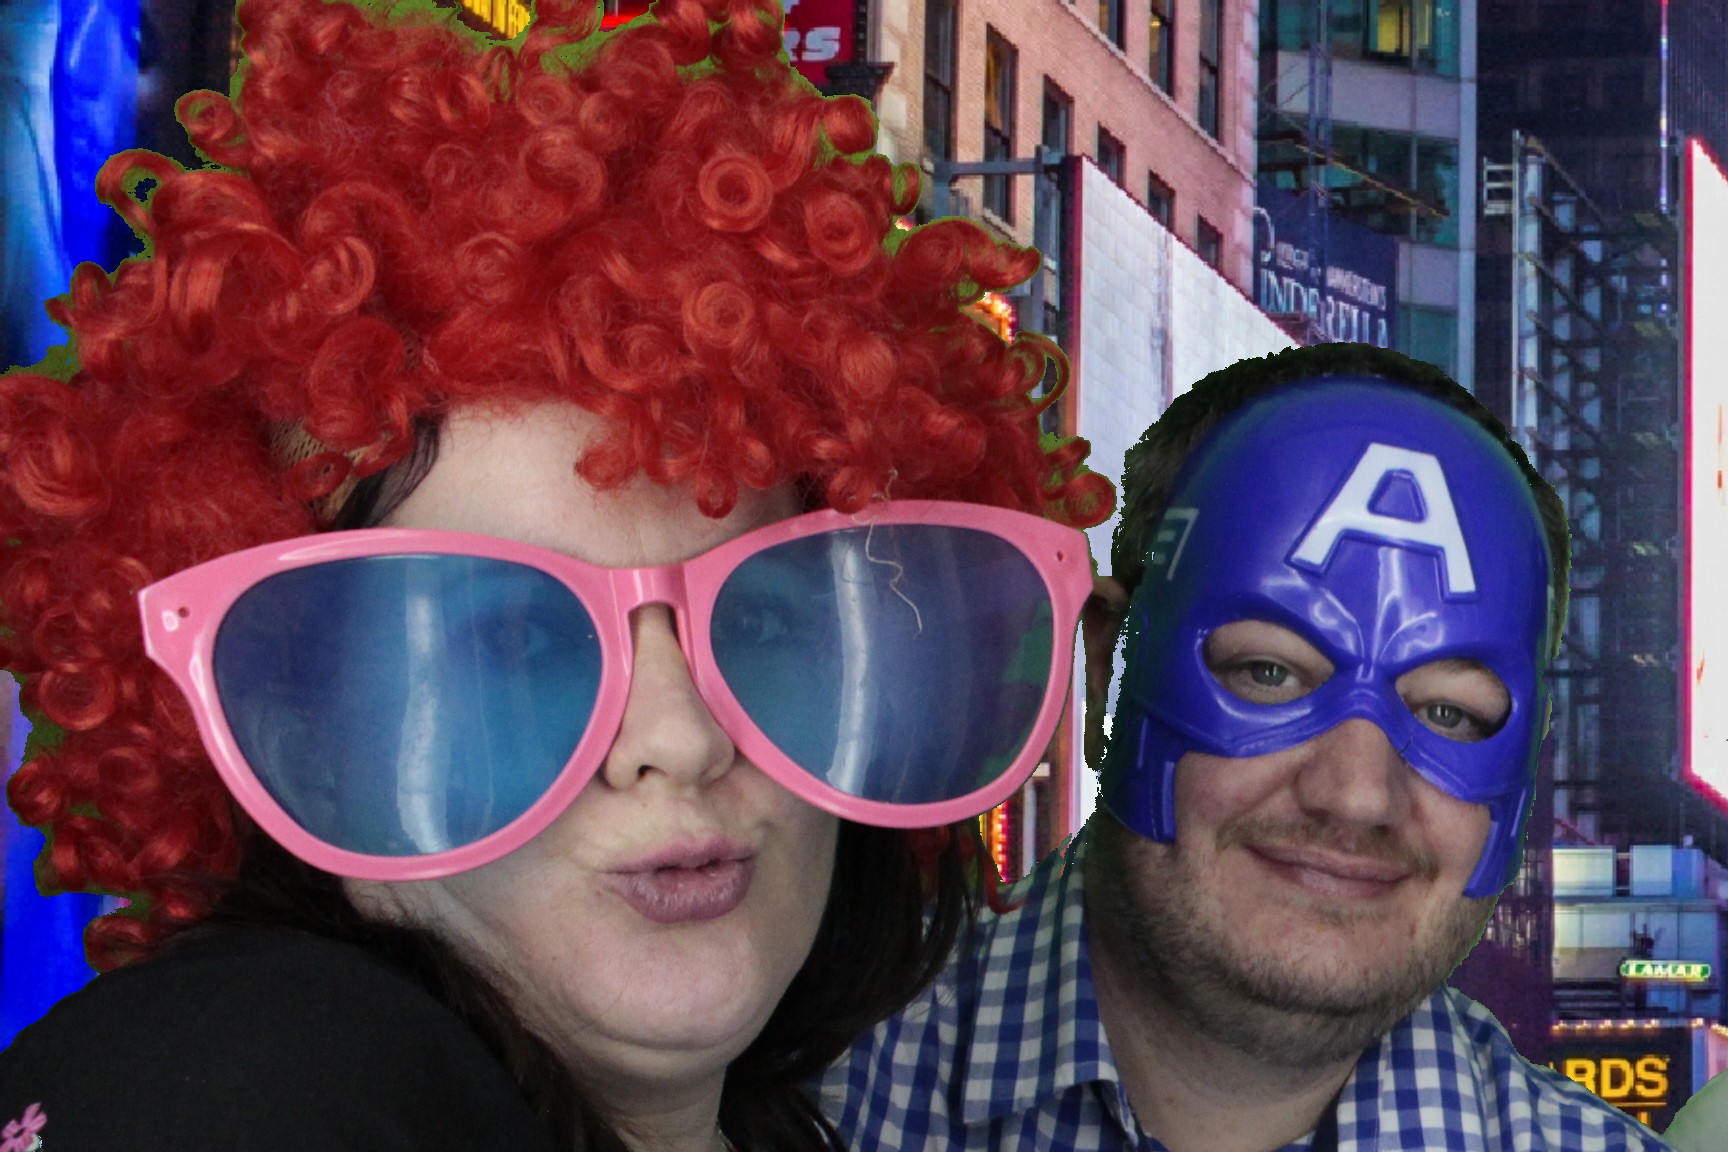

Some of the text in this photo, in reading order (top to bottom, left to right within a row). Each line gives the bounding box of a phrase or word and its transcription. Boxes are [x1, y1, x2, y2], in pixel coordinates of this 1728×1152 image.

[1290, 441, 1477, 593] A
[1628, 960, 1703, 978] LAMAR
[1548, 1056, 1669, 1099] RDS
